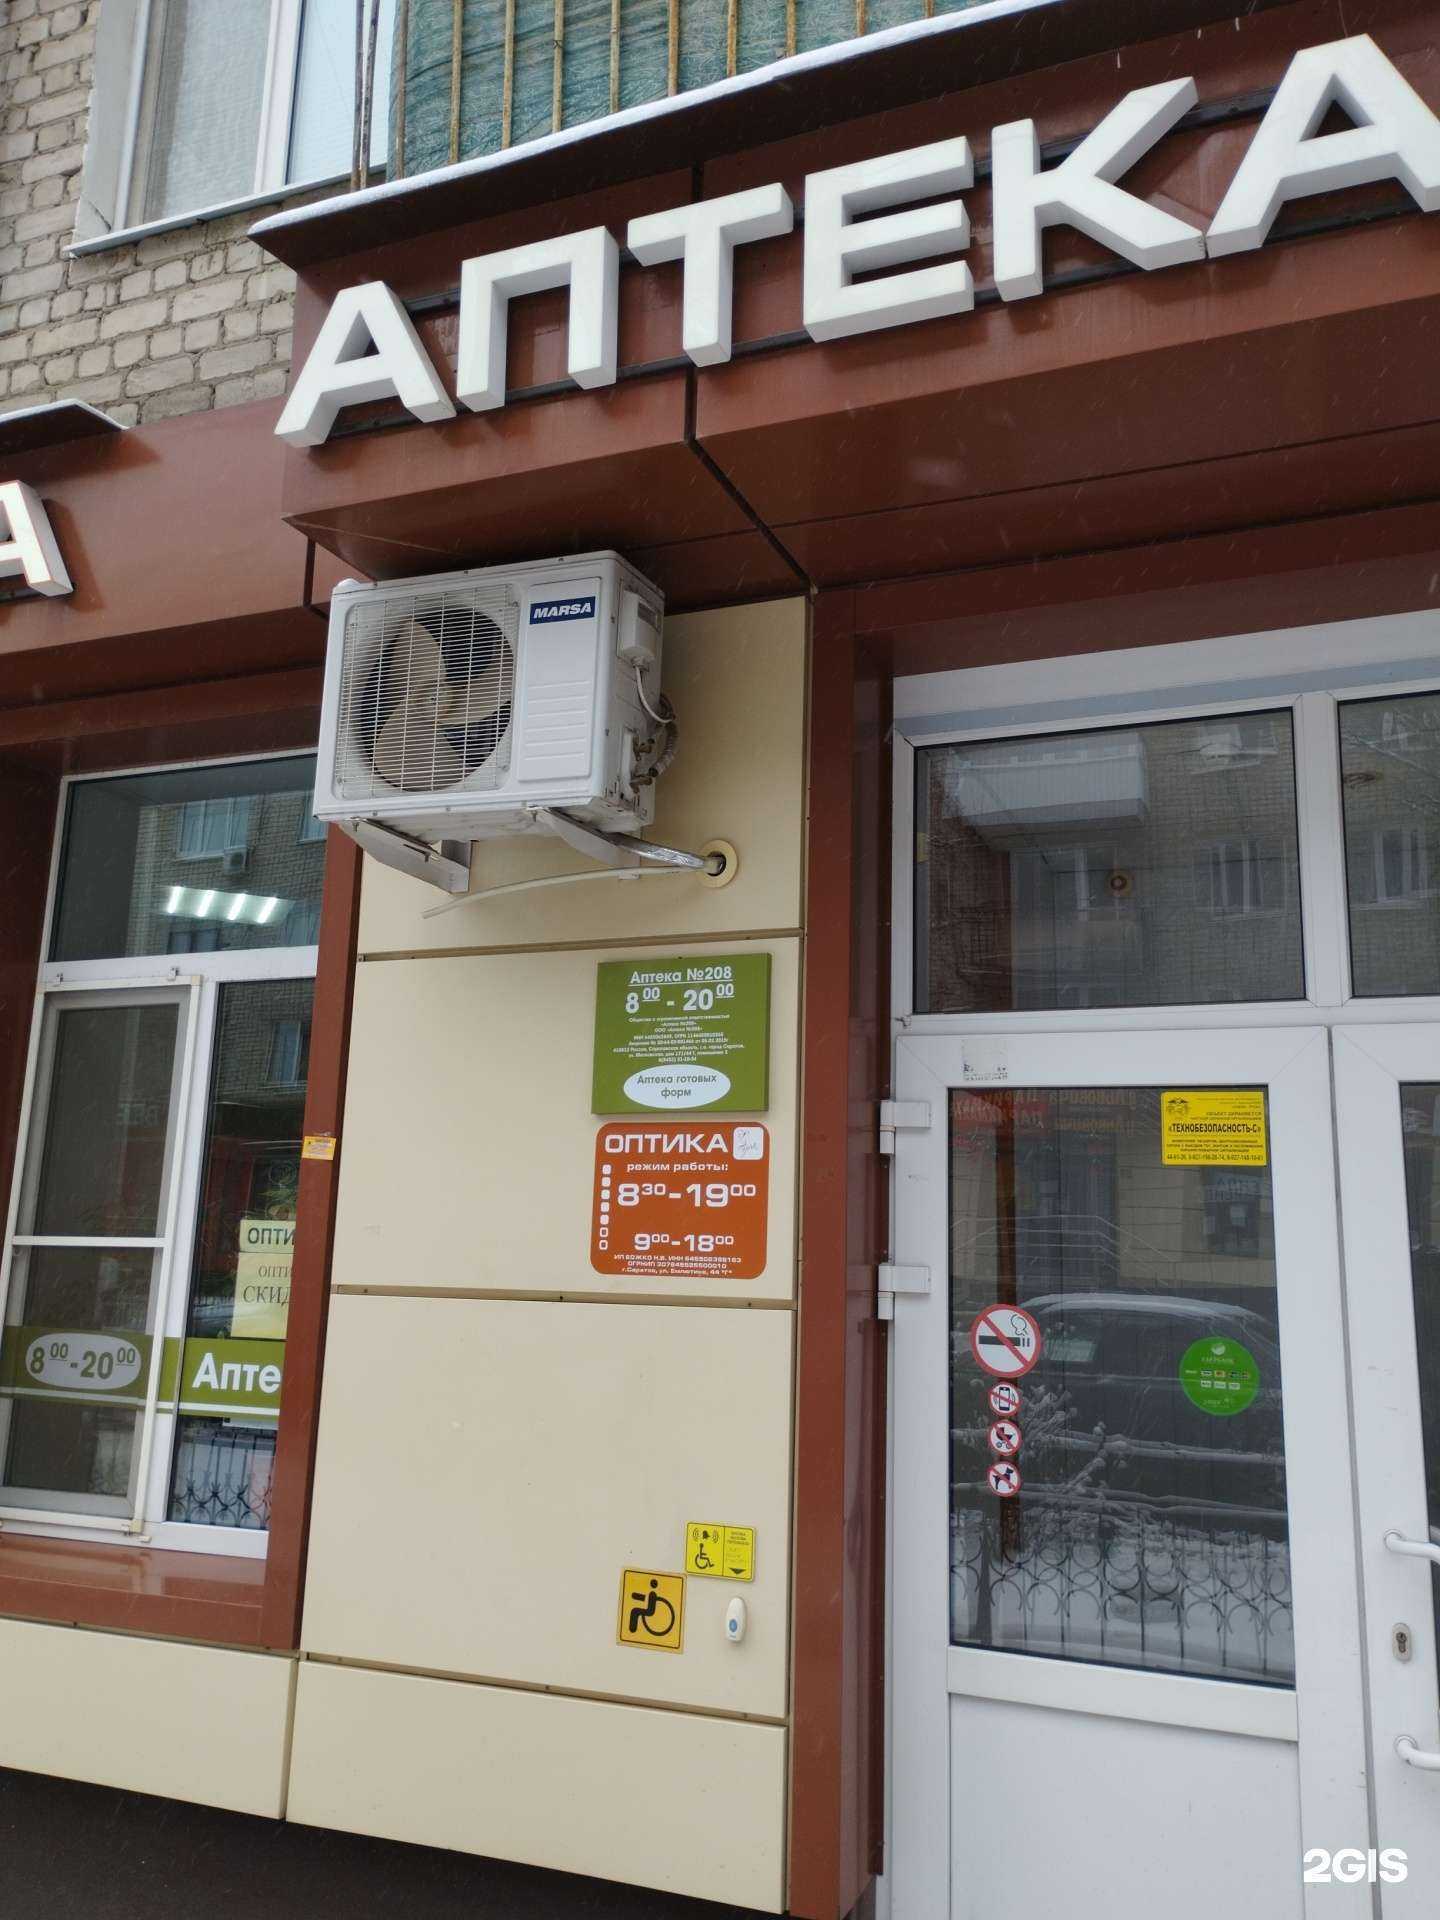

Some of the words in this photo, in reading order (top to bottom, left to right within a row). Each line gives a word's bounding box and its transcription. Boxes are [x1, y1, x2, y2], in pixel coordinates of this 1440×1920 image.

[274, 33, 1440, 447] АПТЕКА
[533, 602, 592, 618] MARSA
[630, 971, 682, 984] Аптека
[686, 966, 732, 981] №208
[637, 1075, 674, 1085] Аптека
[676, 1074, 717, 1084] готовых
[661, 1087, 692, 1099] форм
[605, 1133, 729, 1154] ОПТИКА
[626, 1162, 670, 1173] режим
[673, 1162, 729, 1172] работы:
